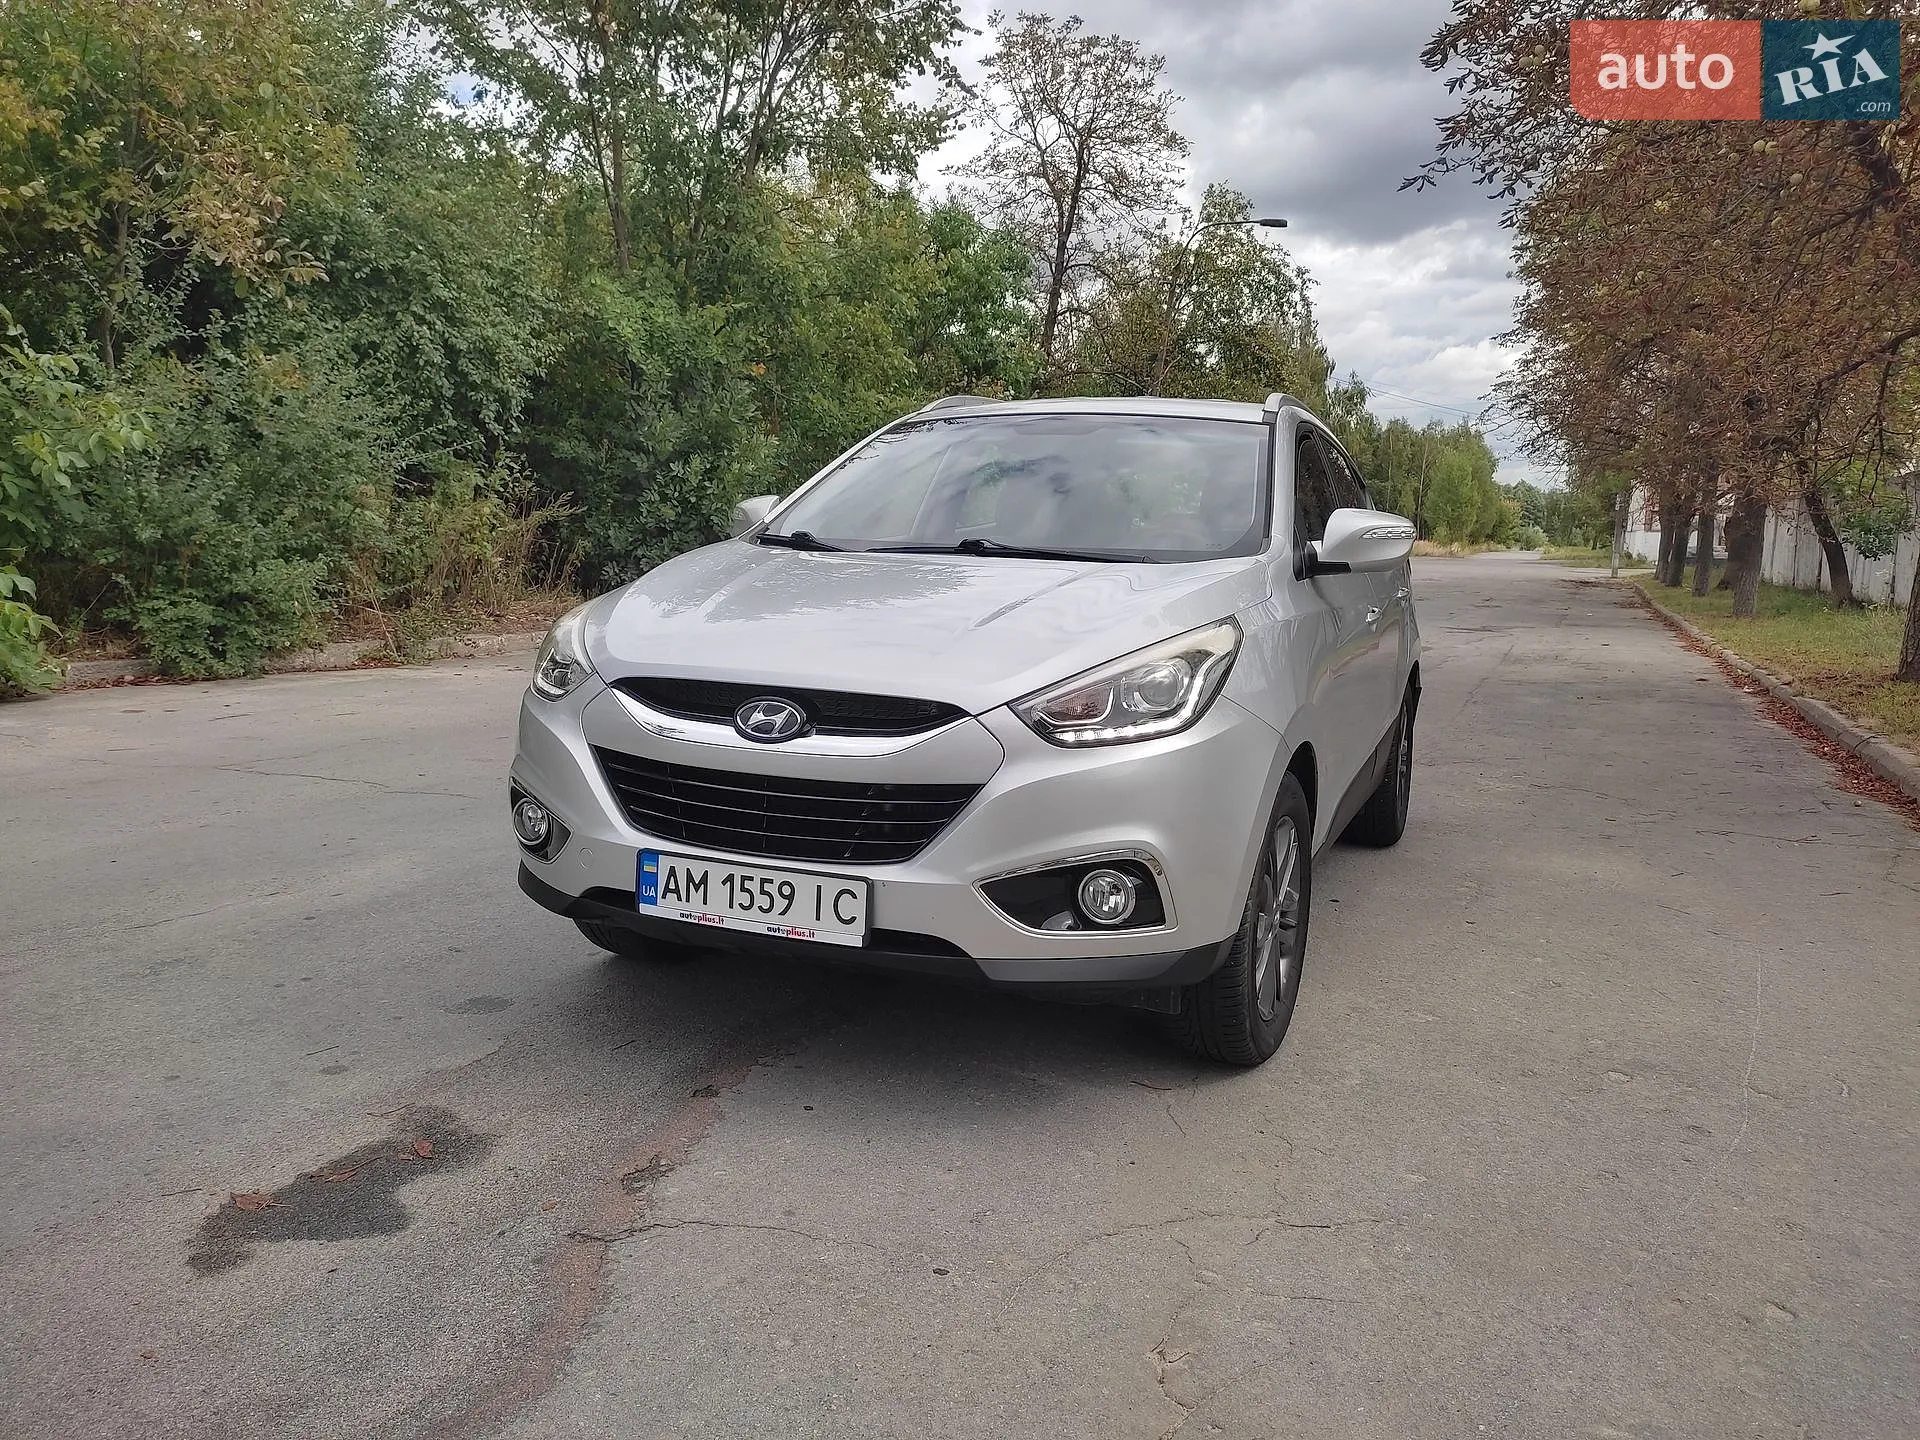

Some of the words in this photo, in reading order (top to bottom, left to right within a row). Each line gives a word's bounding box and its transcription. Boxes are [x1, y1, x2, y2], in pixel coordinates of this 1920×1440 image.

[642, 885, 657, 898] UA
[661, 865, 709, 906] AM
[721, 873, 796, 916] 1559
[815, 884, 859, 926] IC
